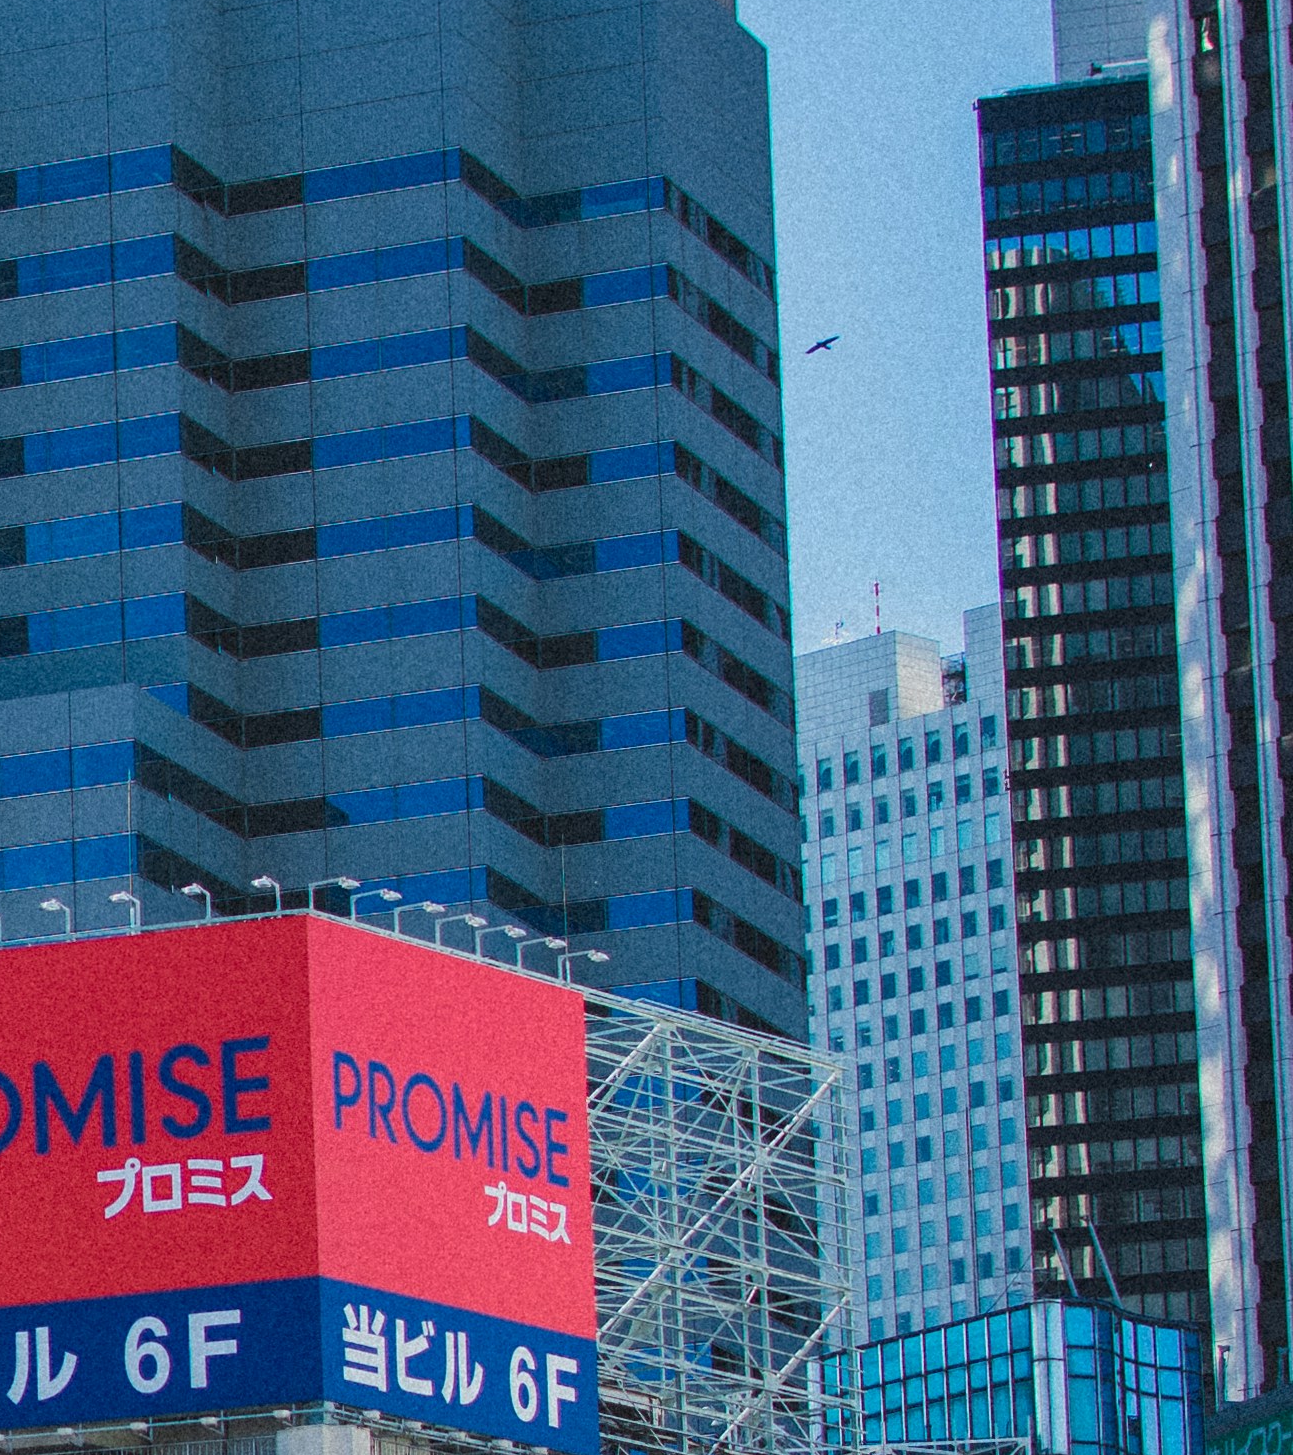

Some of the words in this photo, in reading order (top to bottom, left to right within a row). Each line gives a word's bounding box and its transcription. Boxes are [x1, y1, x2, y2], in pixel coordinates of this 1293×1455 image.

[331, 1051, 571, 1189] PROMISE
[97, 1153, 273, 1219] プロミス
[484, 1181, 572, 1245] プロミス
[124, 1309, 241, 1395] 6F
[342, 1303, 484, 1407] 当ビル
[509, 1345, 579, 1429] 6F
